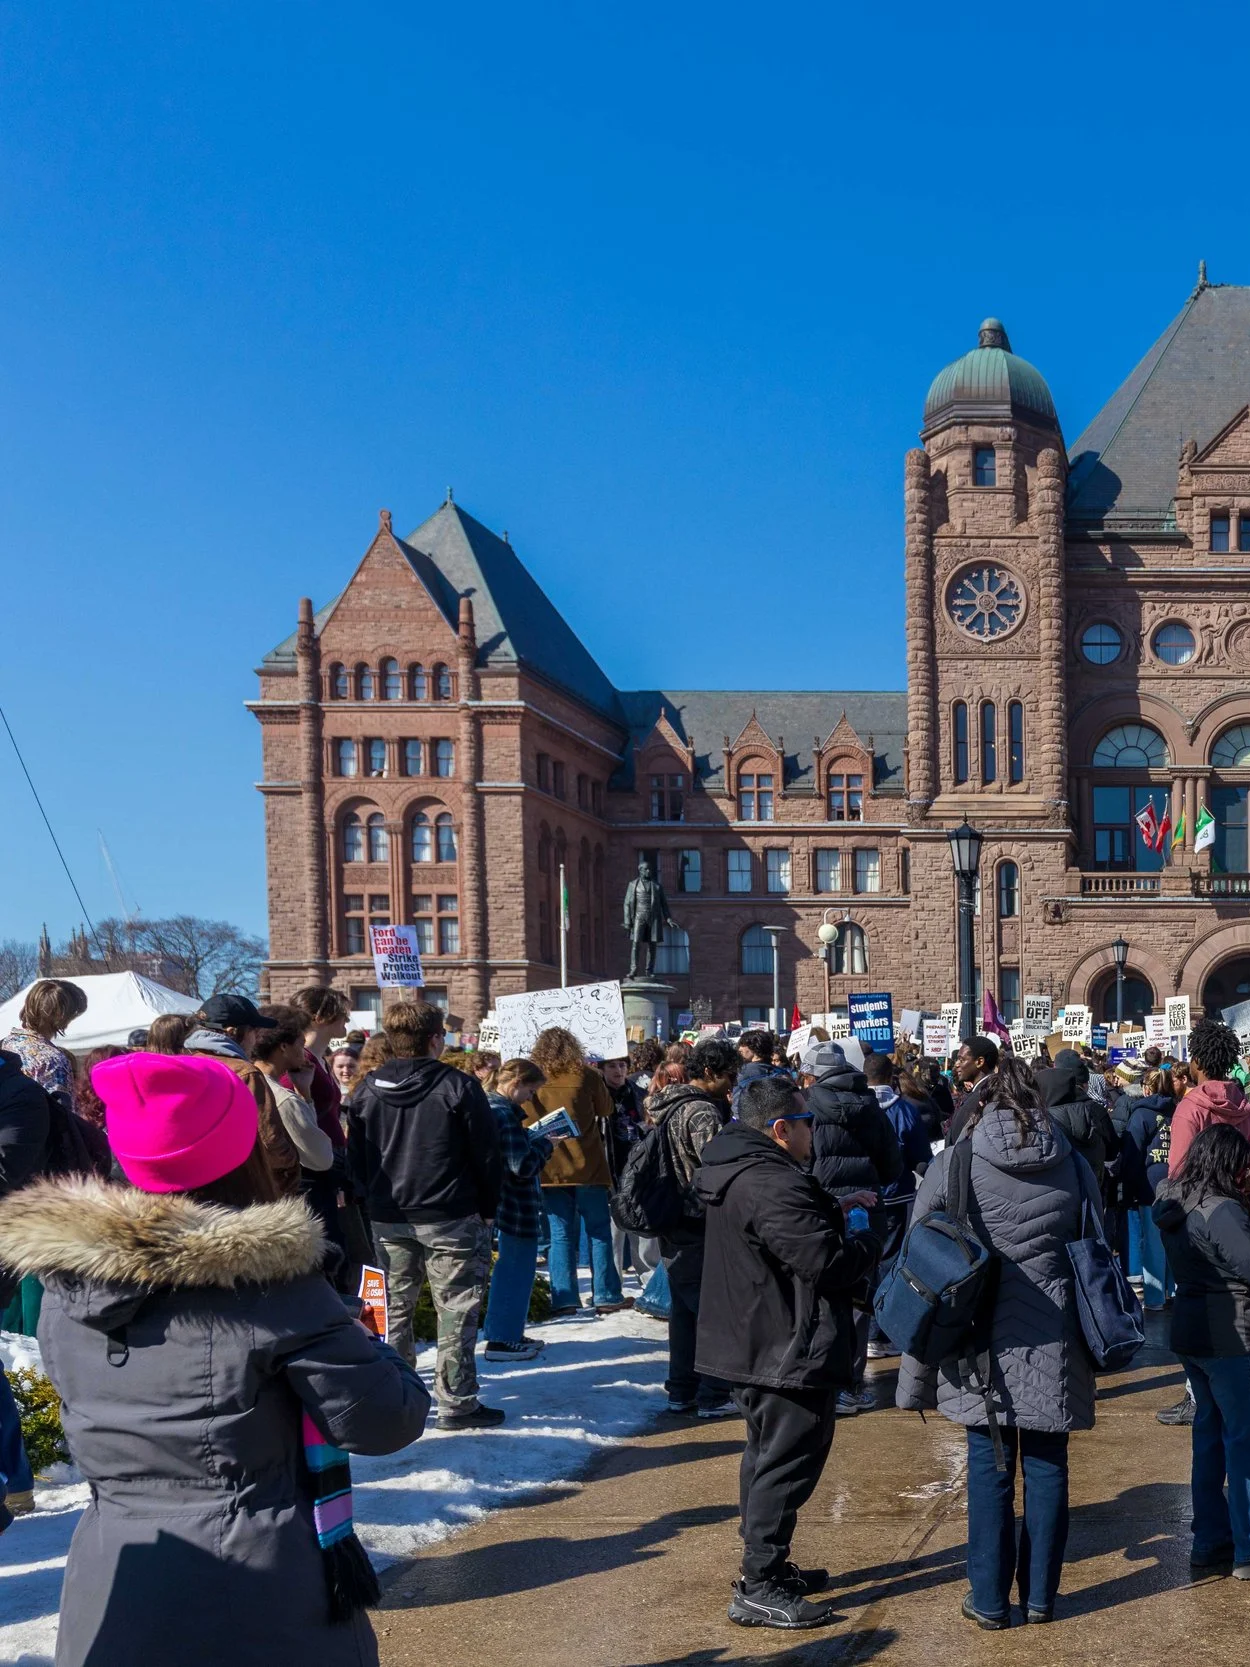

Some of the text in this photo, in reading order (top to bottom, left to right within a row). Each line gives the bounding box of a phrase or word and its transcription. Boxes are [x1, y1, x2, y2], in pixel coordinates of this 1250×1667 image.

[372, 928, 396, 937] Ford
[396, 936, 408, 946] be
[375, 945, 412, 954] beaten
[388, 954, 418, 962] Strike
[382, 962, 421, 972] Protest
[380, 972, 422, 980] Walkout
[850, 1000, 888, 1013] students
[866, 1010, 874, 1020] &
[1026, 1007, 1049, 1019] OFF
[1169, 1011, 1186, 1019] FEES
[853, 1017, 889, 1029] workers
[1065, 1017, 1084, 1026] OFF
[1170, 1018, 1185, 1026] NOT
[481, 1031, 499, 1043] OFF
[833, 1031, 848, 1040] OF
[852, 1028, 891, 1040] UNITED
[1014, 1038, 1036, 1052] OFF
[1126, 1040, 1144, 1049] OFF
